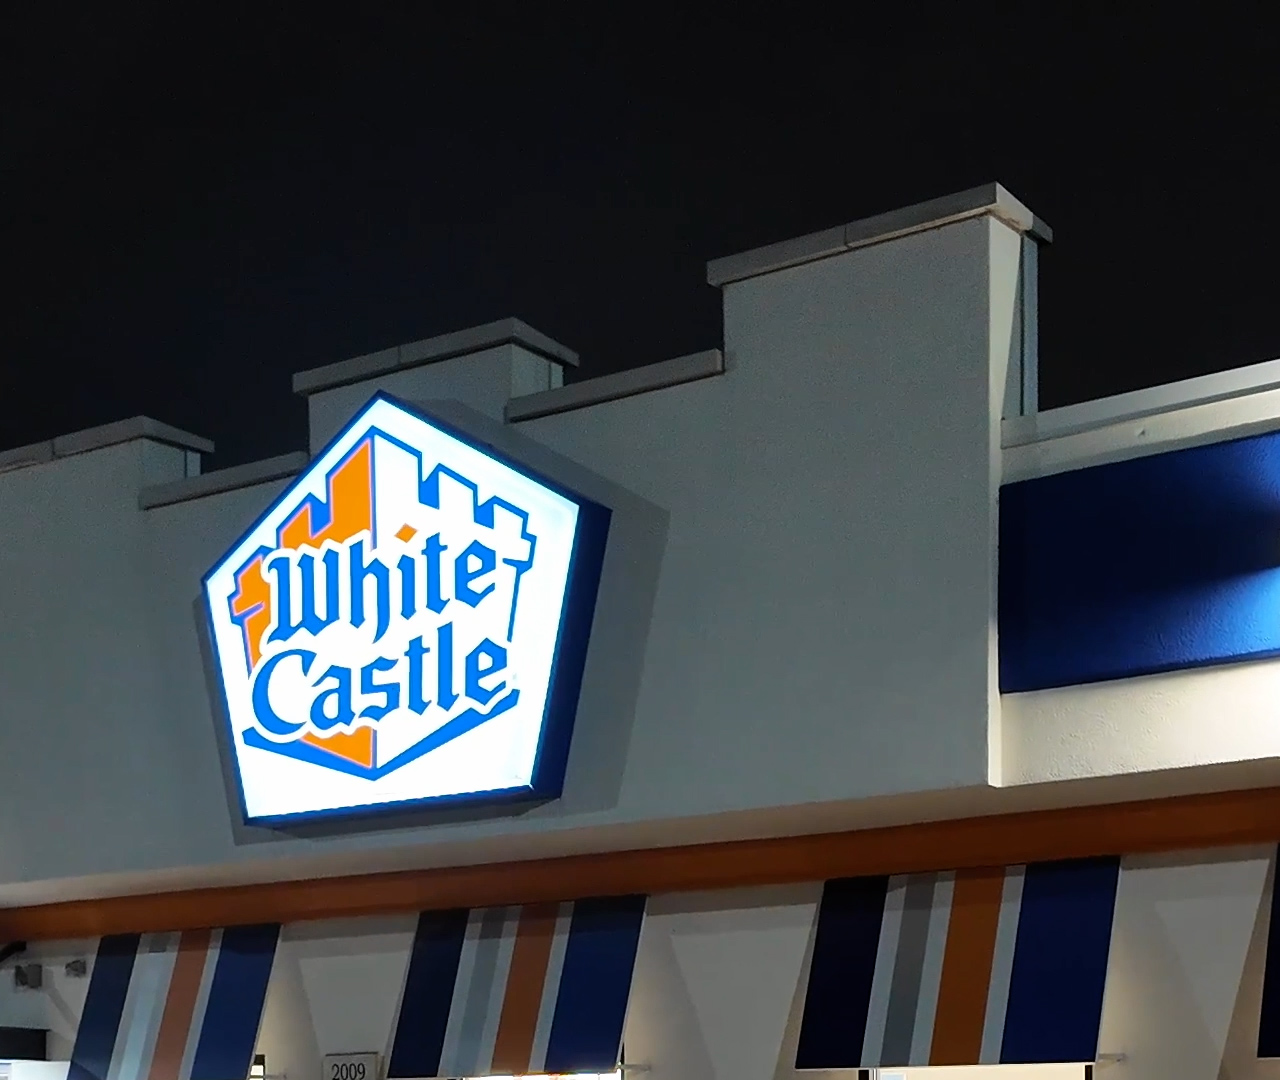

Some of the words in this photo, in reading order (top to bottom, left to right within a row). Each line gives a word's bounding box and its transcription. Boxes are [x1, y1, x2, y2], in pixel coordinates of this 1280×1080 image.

[266, 524, 496, 643] White
[252, 622, 508, 735] Castle
[332, 1063, 366, 1080] 2009
